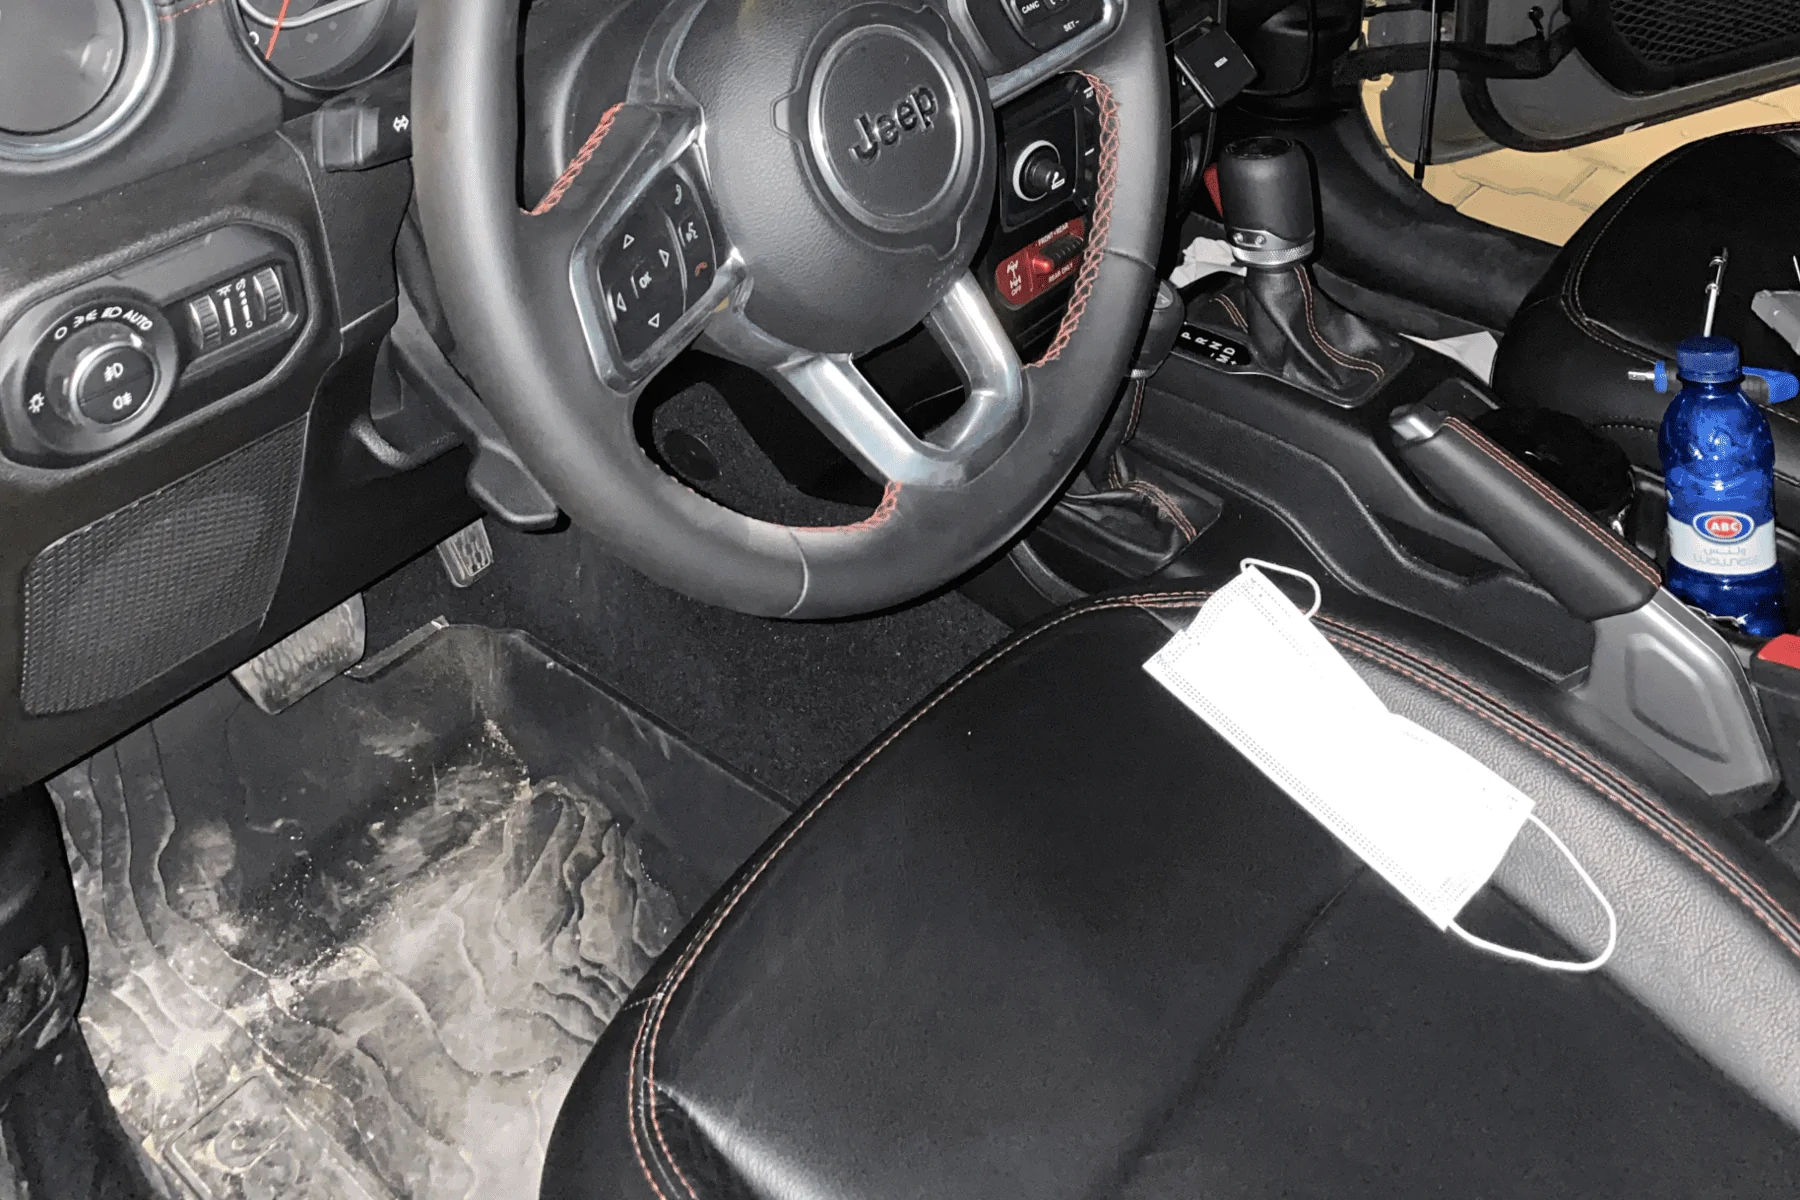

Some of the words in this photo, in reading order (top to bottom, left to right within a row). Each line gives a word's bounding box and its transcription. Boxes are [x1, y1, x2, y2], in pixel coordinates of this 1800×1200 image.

[1021, 0, 1040, 14] CANC
[848, 84, 938, 166] Jeep
[639, 271, 652, 289] OK
[123, 311, 153, 331] AUTO
[1181, 332, 1191, 340] P
[1194, 337, 1208, 345] R
[1711, 522, 1738, 532] ABC
